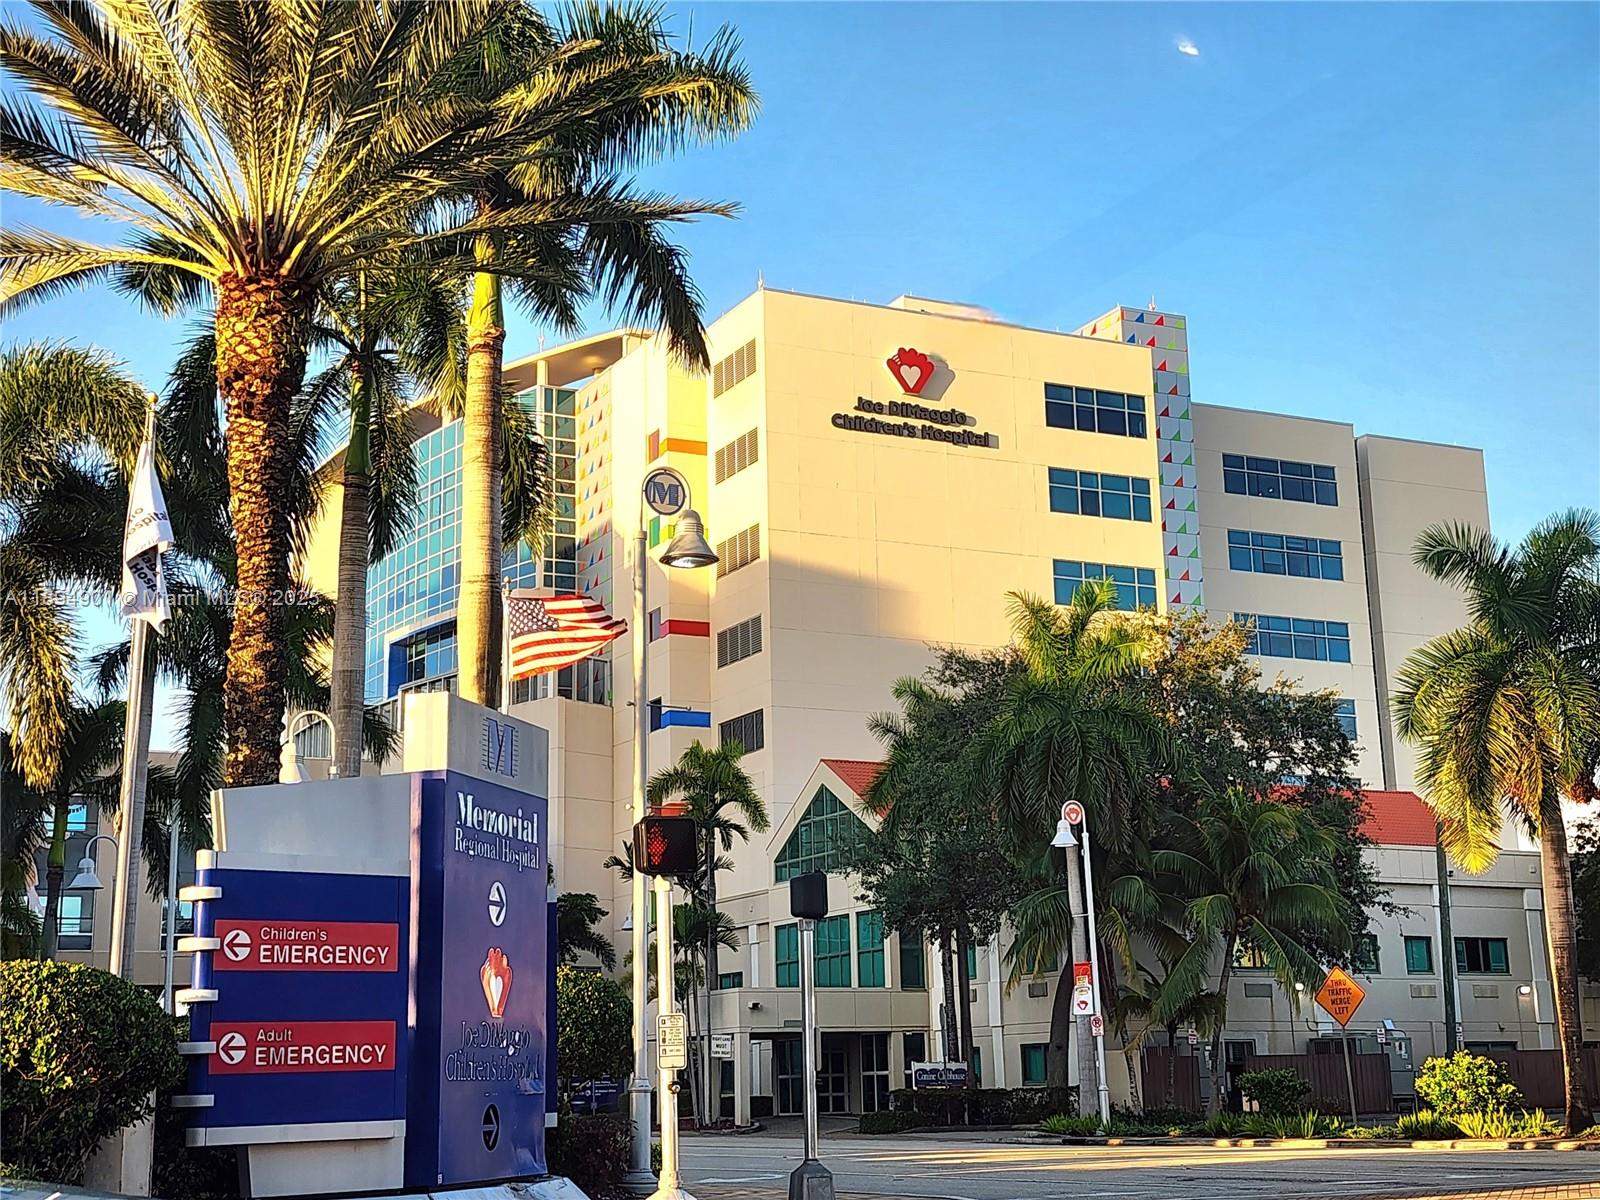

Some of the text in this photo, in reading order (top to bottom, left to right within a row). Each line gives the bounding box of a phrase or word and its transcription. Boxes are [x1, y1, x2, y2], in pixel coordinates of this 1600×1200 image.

[854, 397, 967, 426] Joe DiMaggio
[831, 413, 990, 447] Children's Hospital
[456, 791, 539, 844] Memorial
[454, 828, 540, 872] Regional Hospital
[260, 927, 328, 941] Children's
[259, 945, 389, 964] EMERGENCY
[1327, 988, 1353, 996] TRAFFIC
[1330, 997, 1351, 1005] MERGE
[1334, 1006, 1349, 1015] LEFT
[256, 1029, 292, 1041] Adult
[459, 1020, 479, 1054] Joe
[255, 1044, 387, 1066] EMERGENCY
[446, 1052, 498, 1081] Children's
